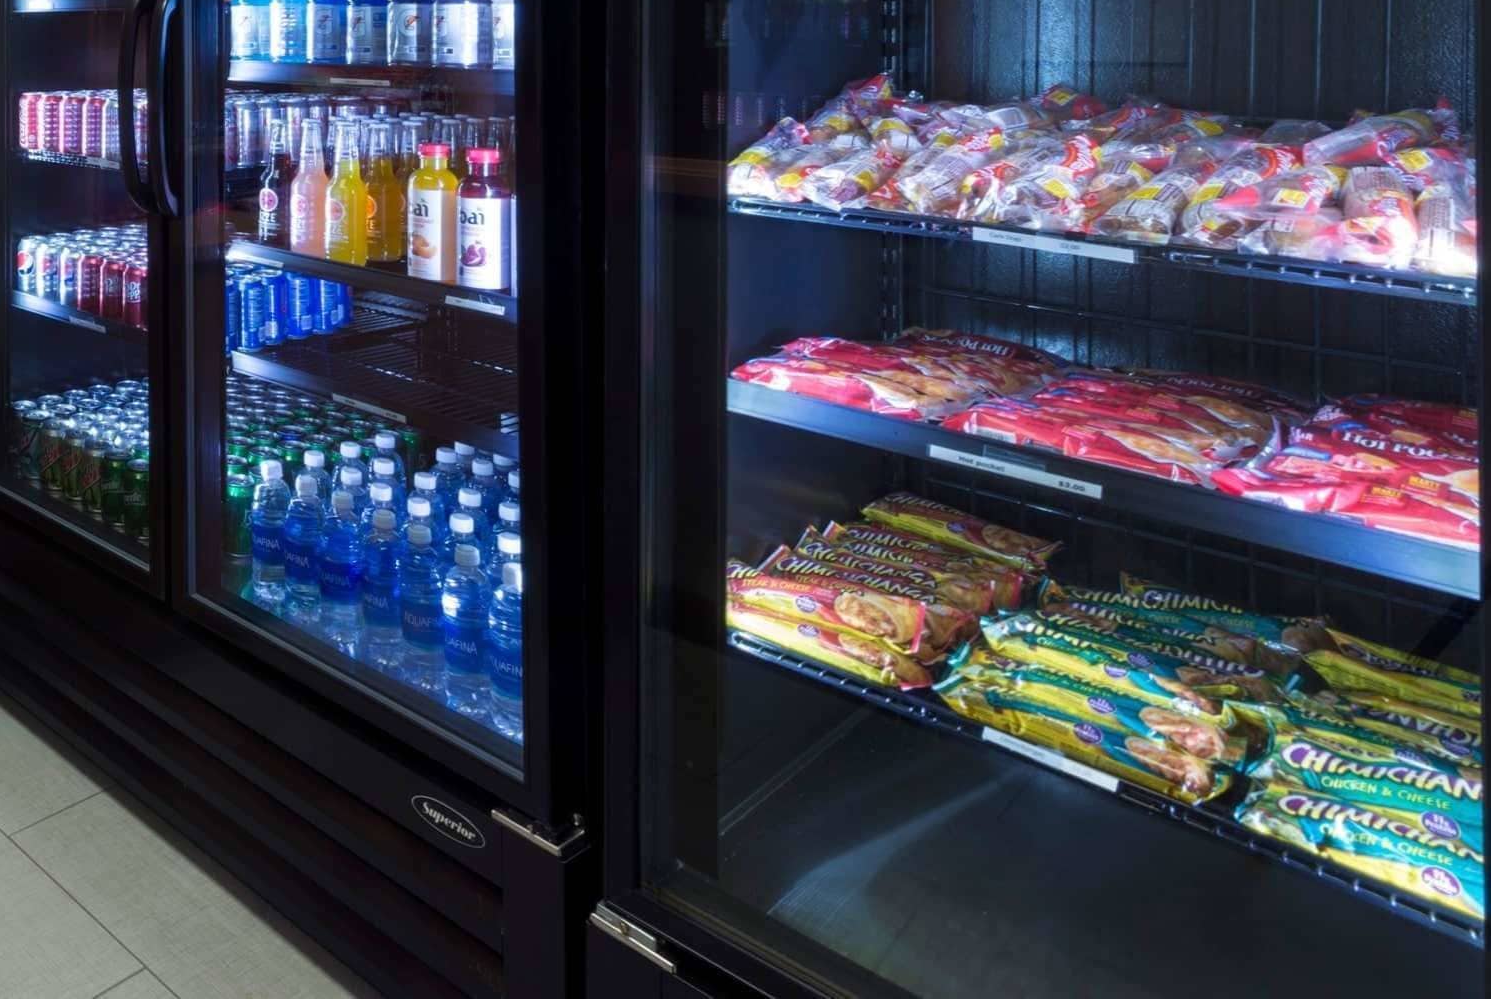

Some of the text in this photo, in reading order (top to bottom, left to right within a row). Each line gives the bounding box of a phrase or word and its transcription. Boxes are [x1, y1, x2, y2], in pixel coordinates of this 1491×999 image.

[1320, 775, 1377, 794] CHICKEN
[1397, 790, 1451, 810] CHEESE
[422, 801, 477, 840] Superior
[1397, 842, 1454, 866] CHEESE
